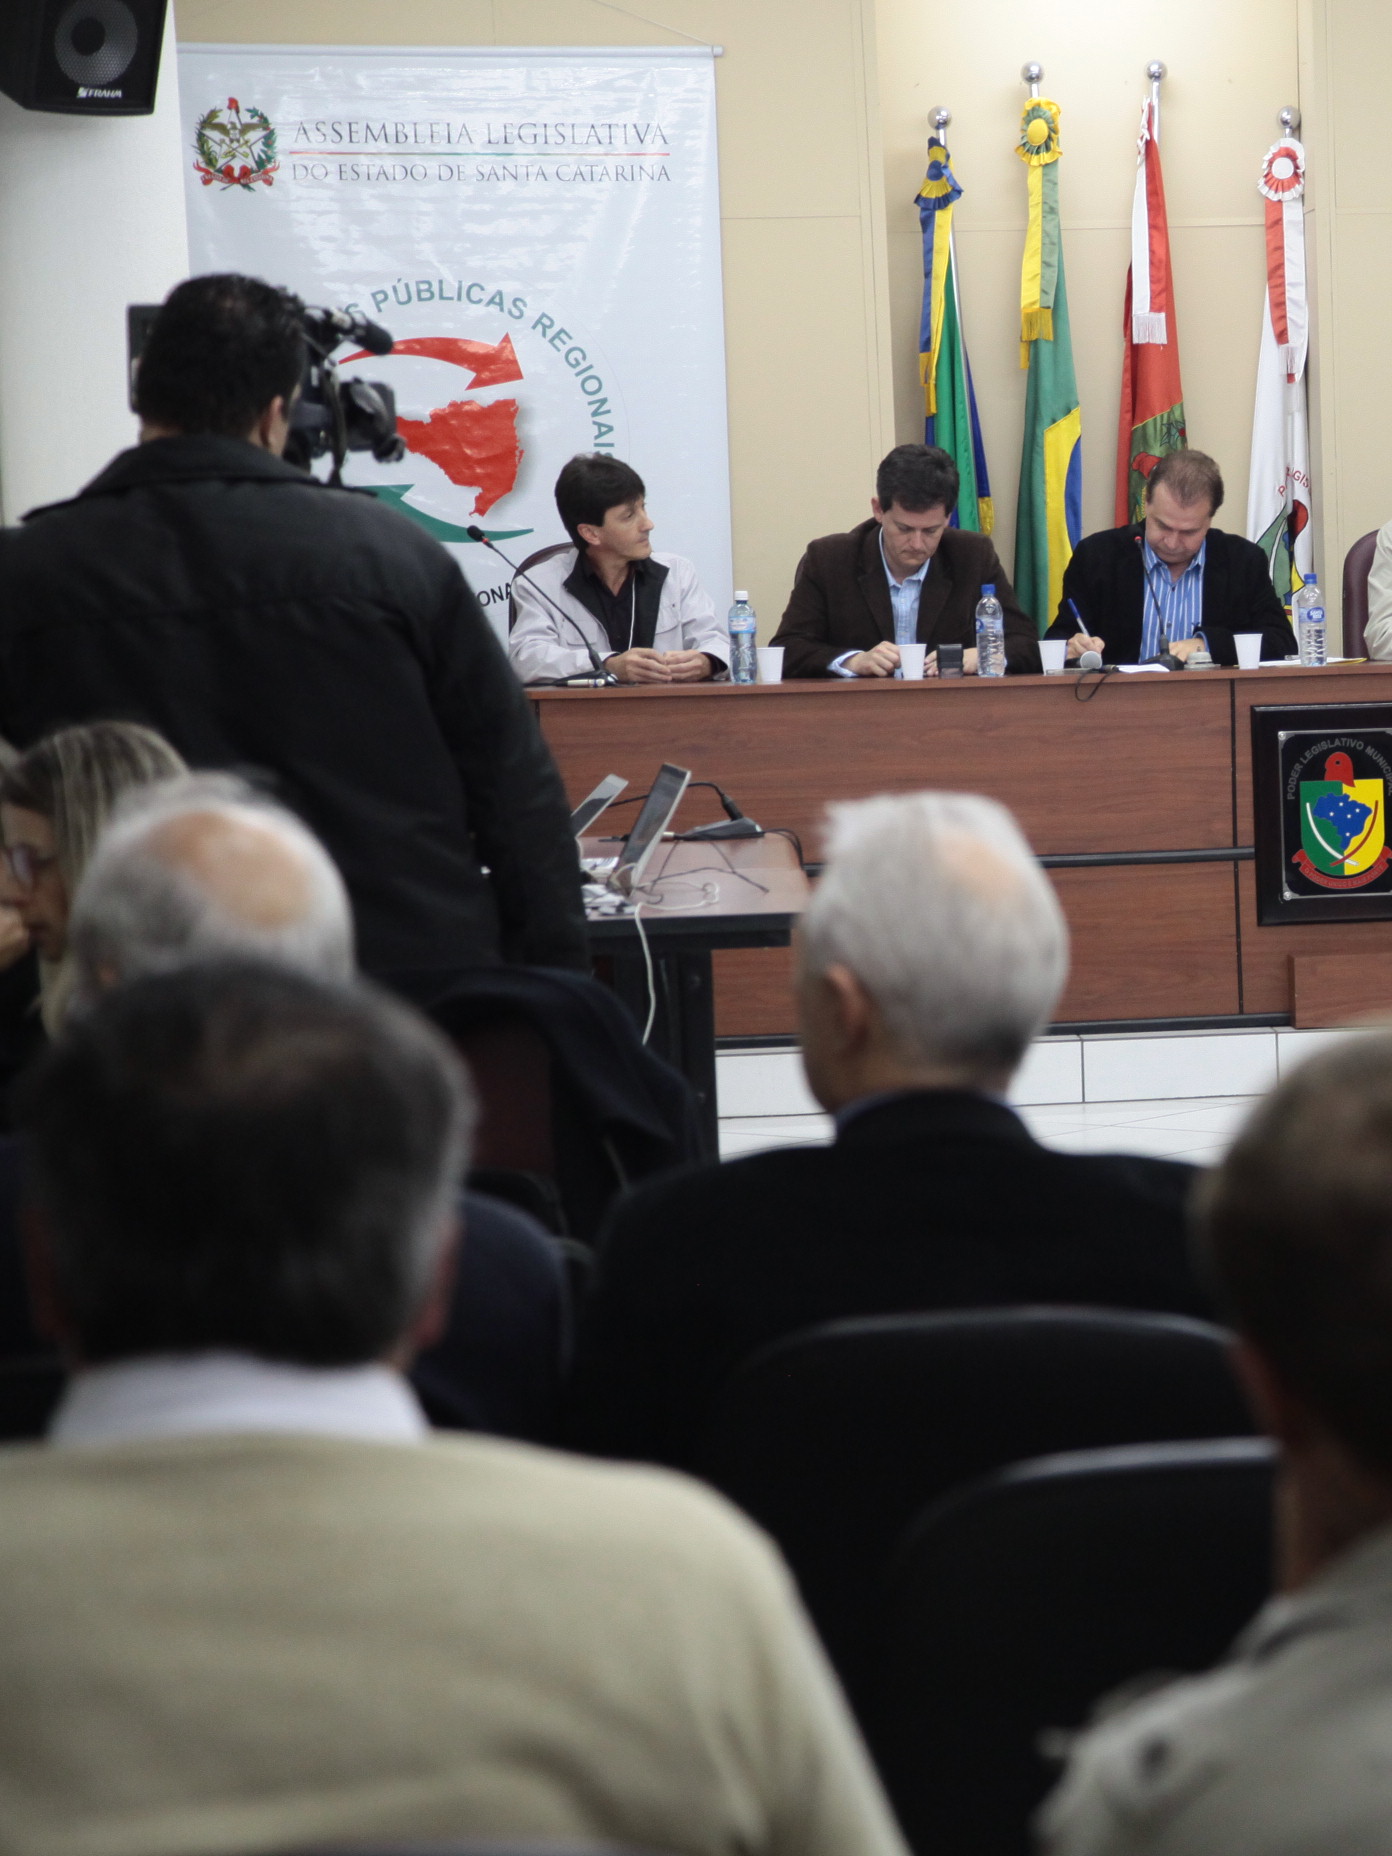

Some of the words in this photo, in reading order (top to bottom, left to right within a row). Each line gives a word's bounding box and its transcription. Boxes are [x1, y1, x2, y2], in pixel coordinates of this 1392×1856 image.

[294, 121, 474, 144] ASSEMBLEIA
[486, 122, 670, 145] LEGISLATIVA
[291, 163, 328, 182] DO
[338, 163, 428, 182] ESTADO
[438, 163, 466, 182] DE
[475, 163, 546, 182] SANTA
[555, 164, 671, 182] CATARINA
[370, 278, 528, 320] PÚBLICAS
[530, 312, 616, 457] REGIONAI
[1287, 762, 1304, 800] PODER
[1300, 738, 1365, 764] LEGISLATIVO
